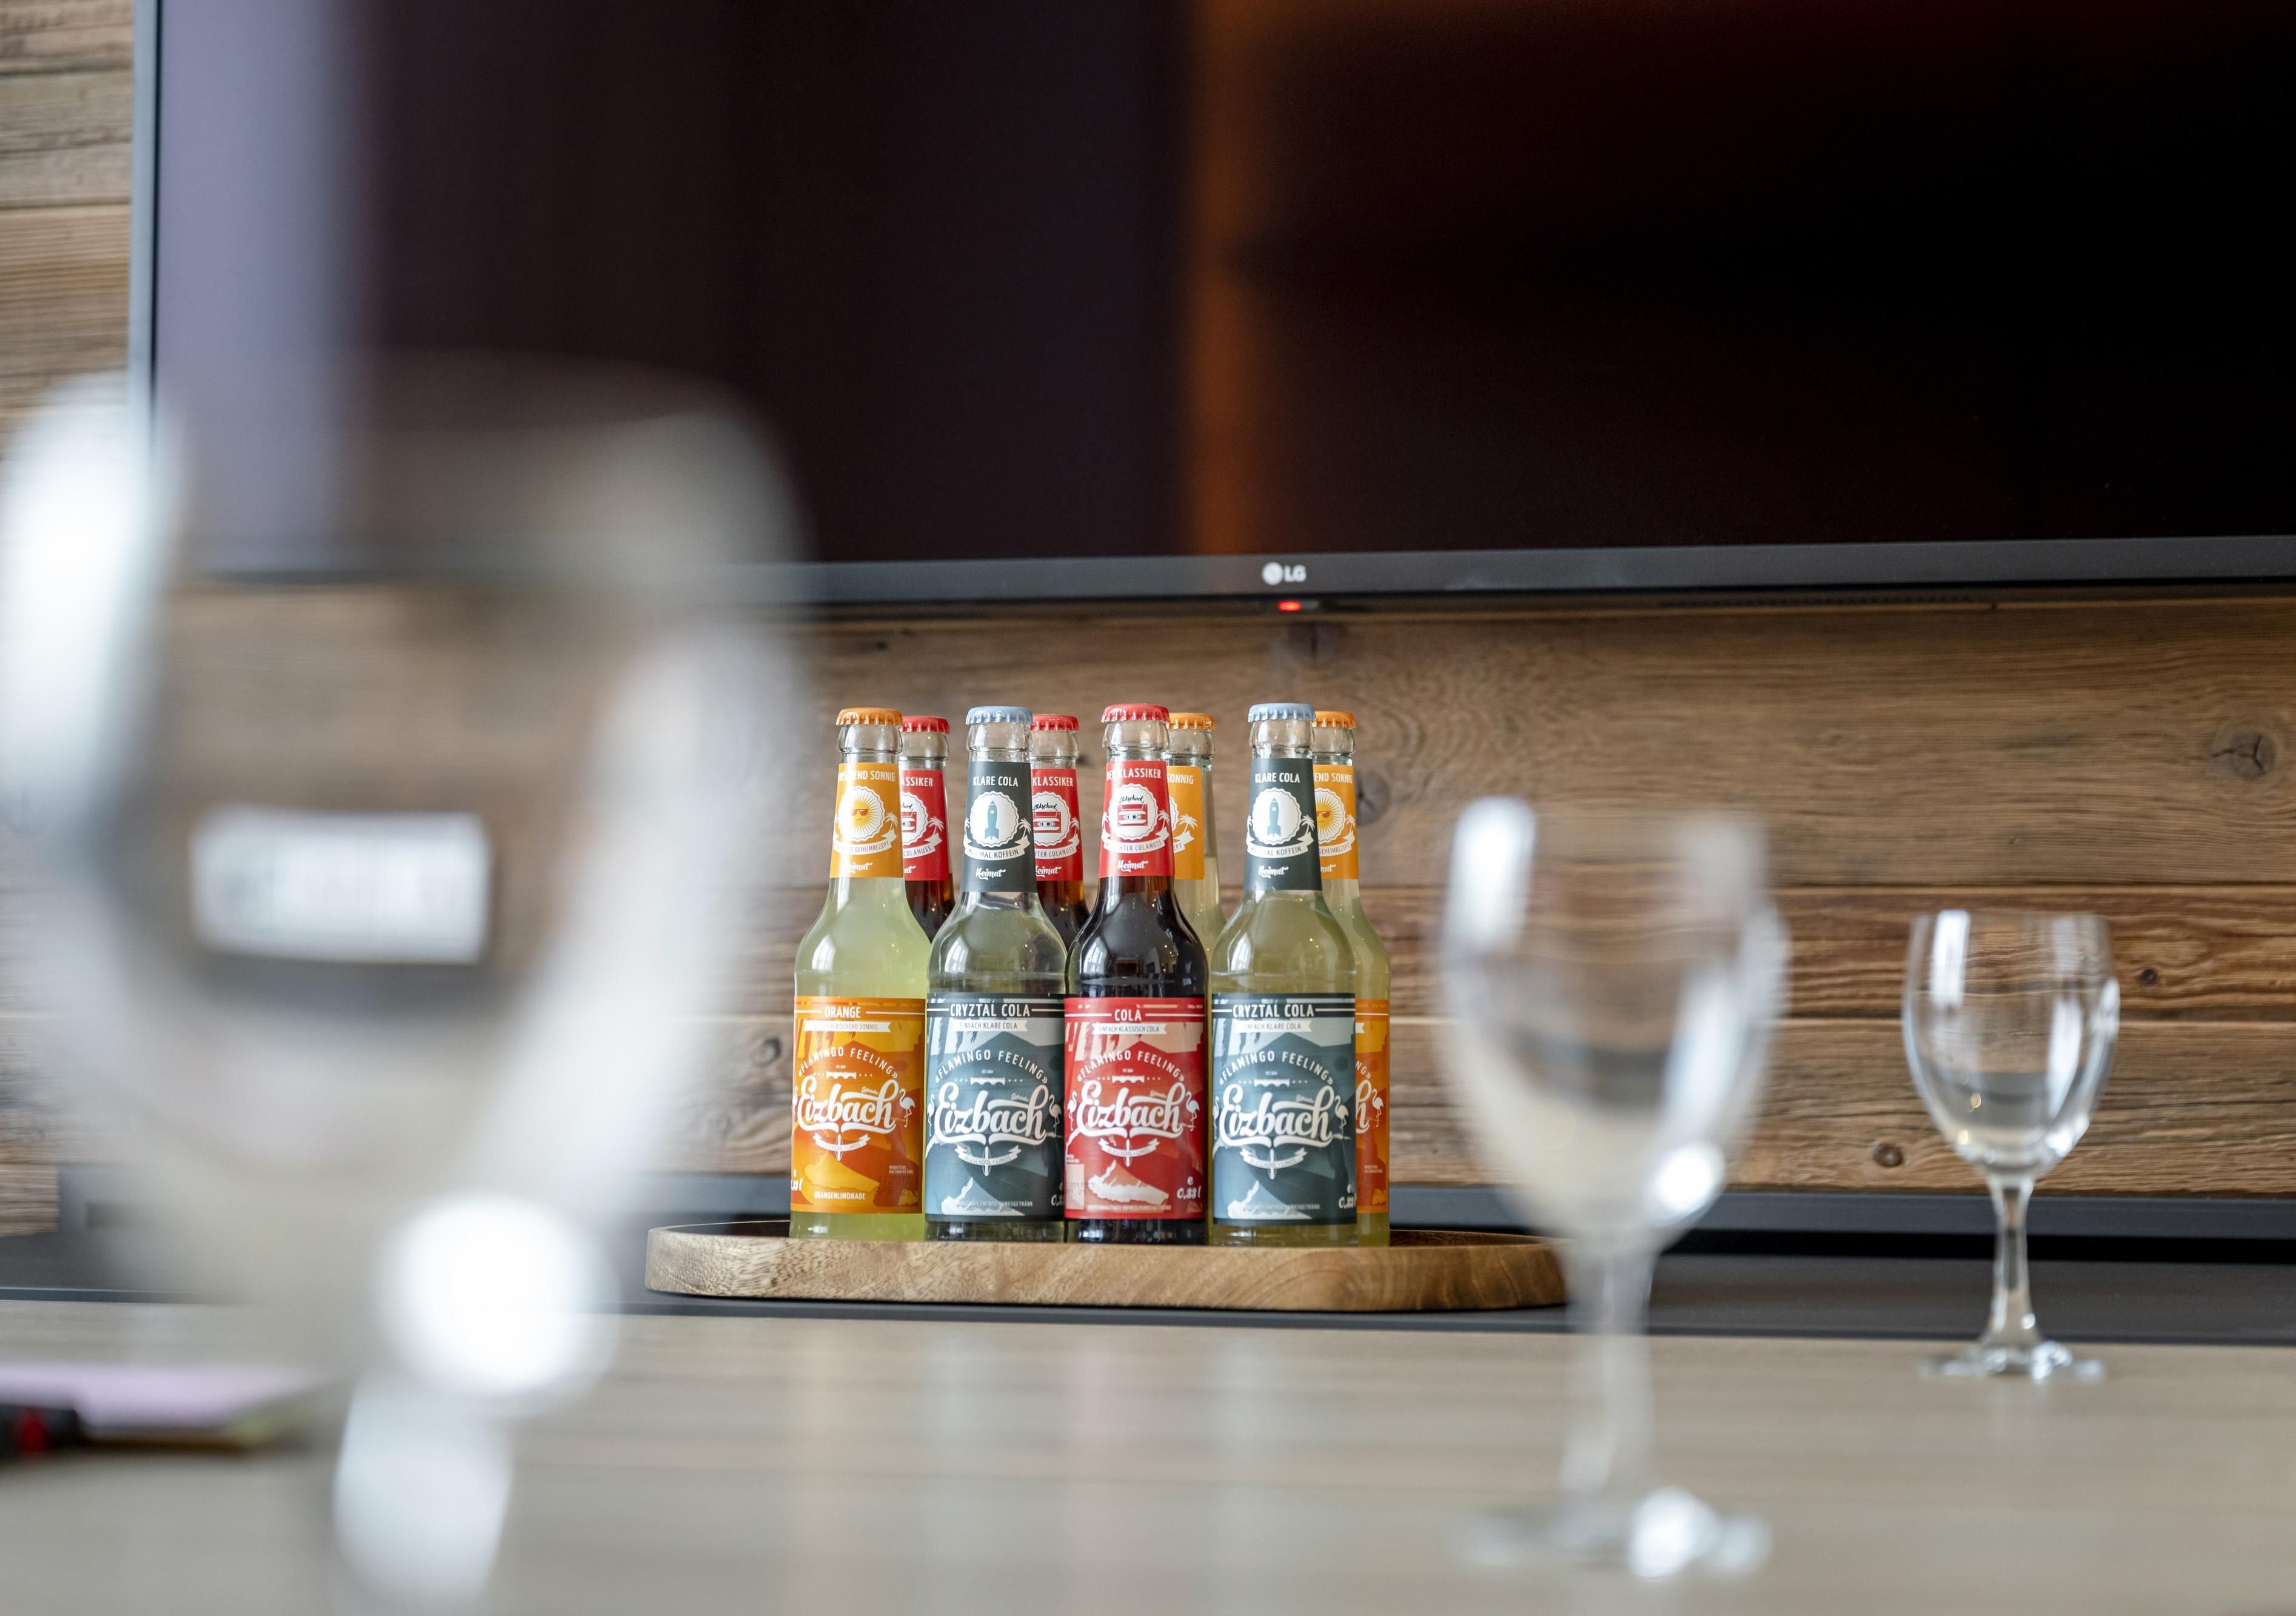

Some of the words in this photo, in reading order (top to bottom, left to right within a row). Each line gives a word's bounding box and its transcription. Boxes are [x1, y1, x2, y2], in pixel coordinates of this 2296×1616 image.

[1284, 564, 1307, 582] LG
[870, 771, 895, 781] SONNIG
[902, 777, 934, 787] ASSIKER
[972, 776, 996, 786] KLARE
[998, 776, 1019, 787] COLA
[1033, 776, 1073, 787] KLASSIKER
[1255, 772, 1276, 783] KLARE
[1279, 772, 1300, 783] COLA
[1332, 773, 1353, 784] SONNIG
[855, 841, 889, 853] GEHEIMREZEPT
[1049, 846, 1075, 857] COLANUSS
[1135, 841, 1162, 852] COLANUSS
[1276, 846, 1302, 855] KOFFEIN
[994, 849, 1019, 858] KOFFEIN
[1117, 860, 1149, 873] Heimat
[1258, 865, 1289, 879] Heimat
[976, 867, 1006, 881] Heimat
[824, 1006, 862, 1018] ORANGE
[950, 1003, 997, 1017] CRYZTAL
[1001, 1003, 1031, 1017] COLA
[1114, 1009, 1142, 1021] COLA
[1233, 1004, 1280, 1018] CRYZTAL
[1284, 1004, 1314, 1017] COLA
[797, 1075, 899, 1134] Eizbach
[1077, 1080, 1185, 1138] Eizbach
[934, 1081, 1049, 1146] Eizbach
[1219, 1084, 1334, 1148] Eizbach
[814, 1191, 866, 1200] ORANGENLIMONADE
